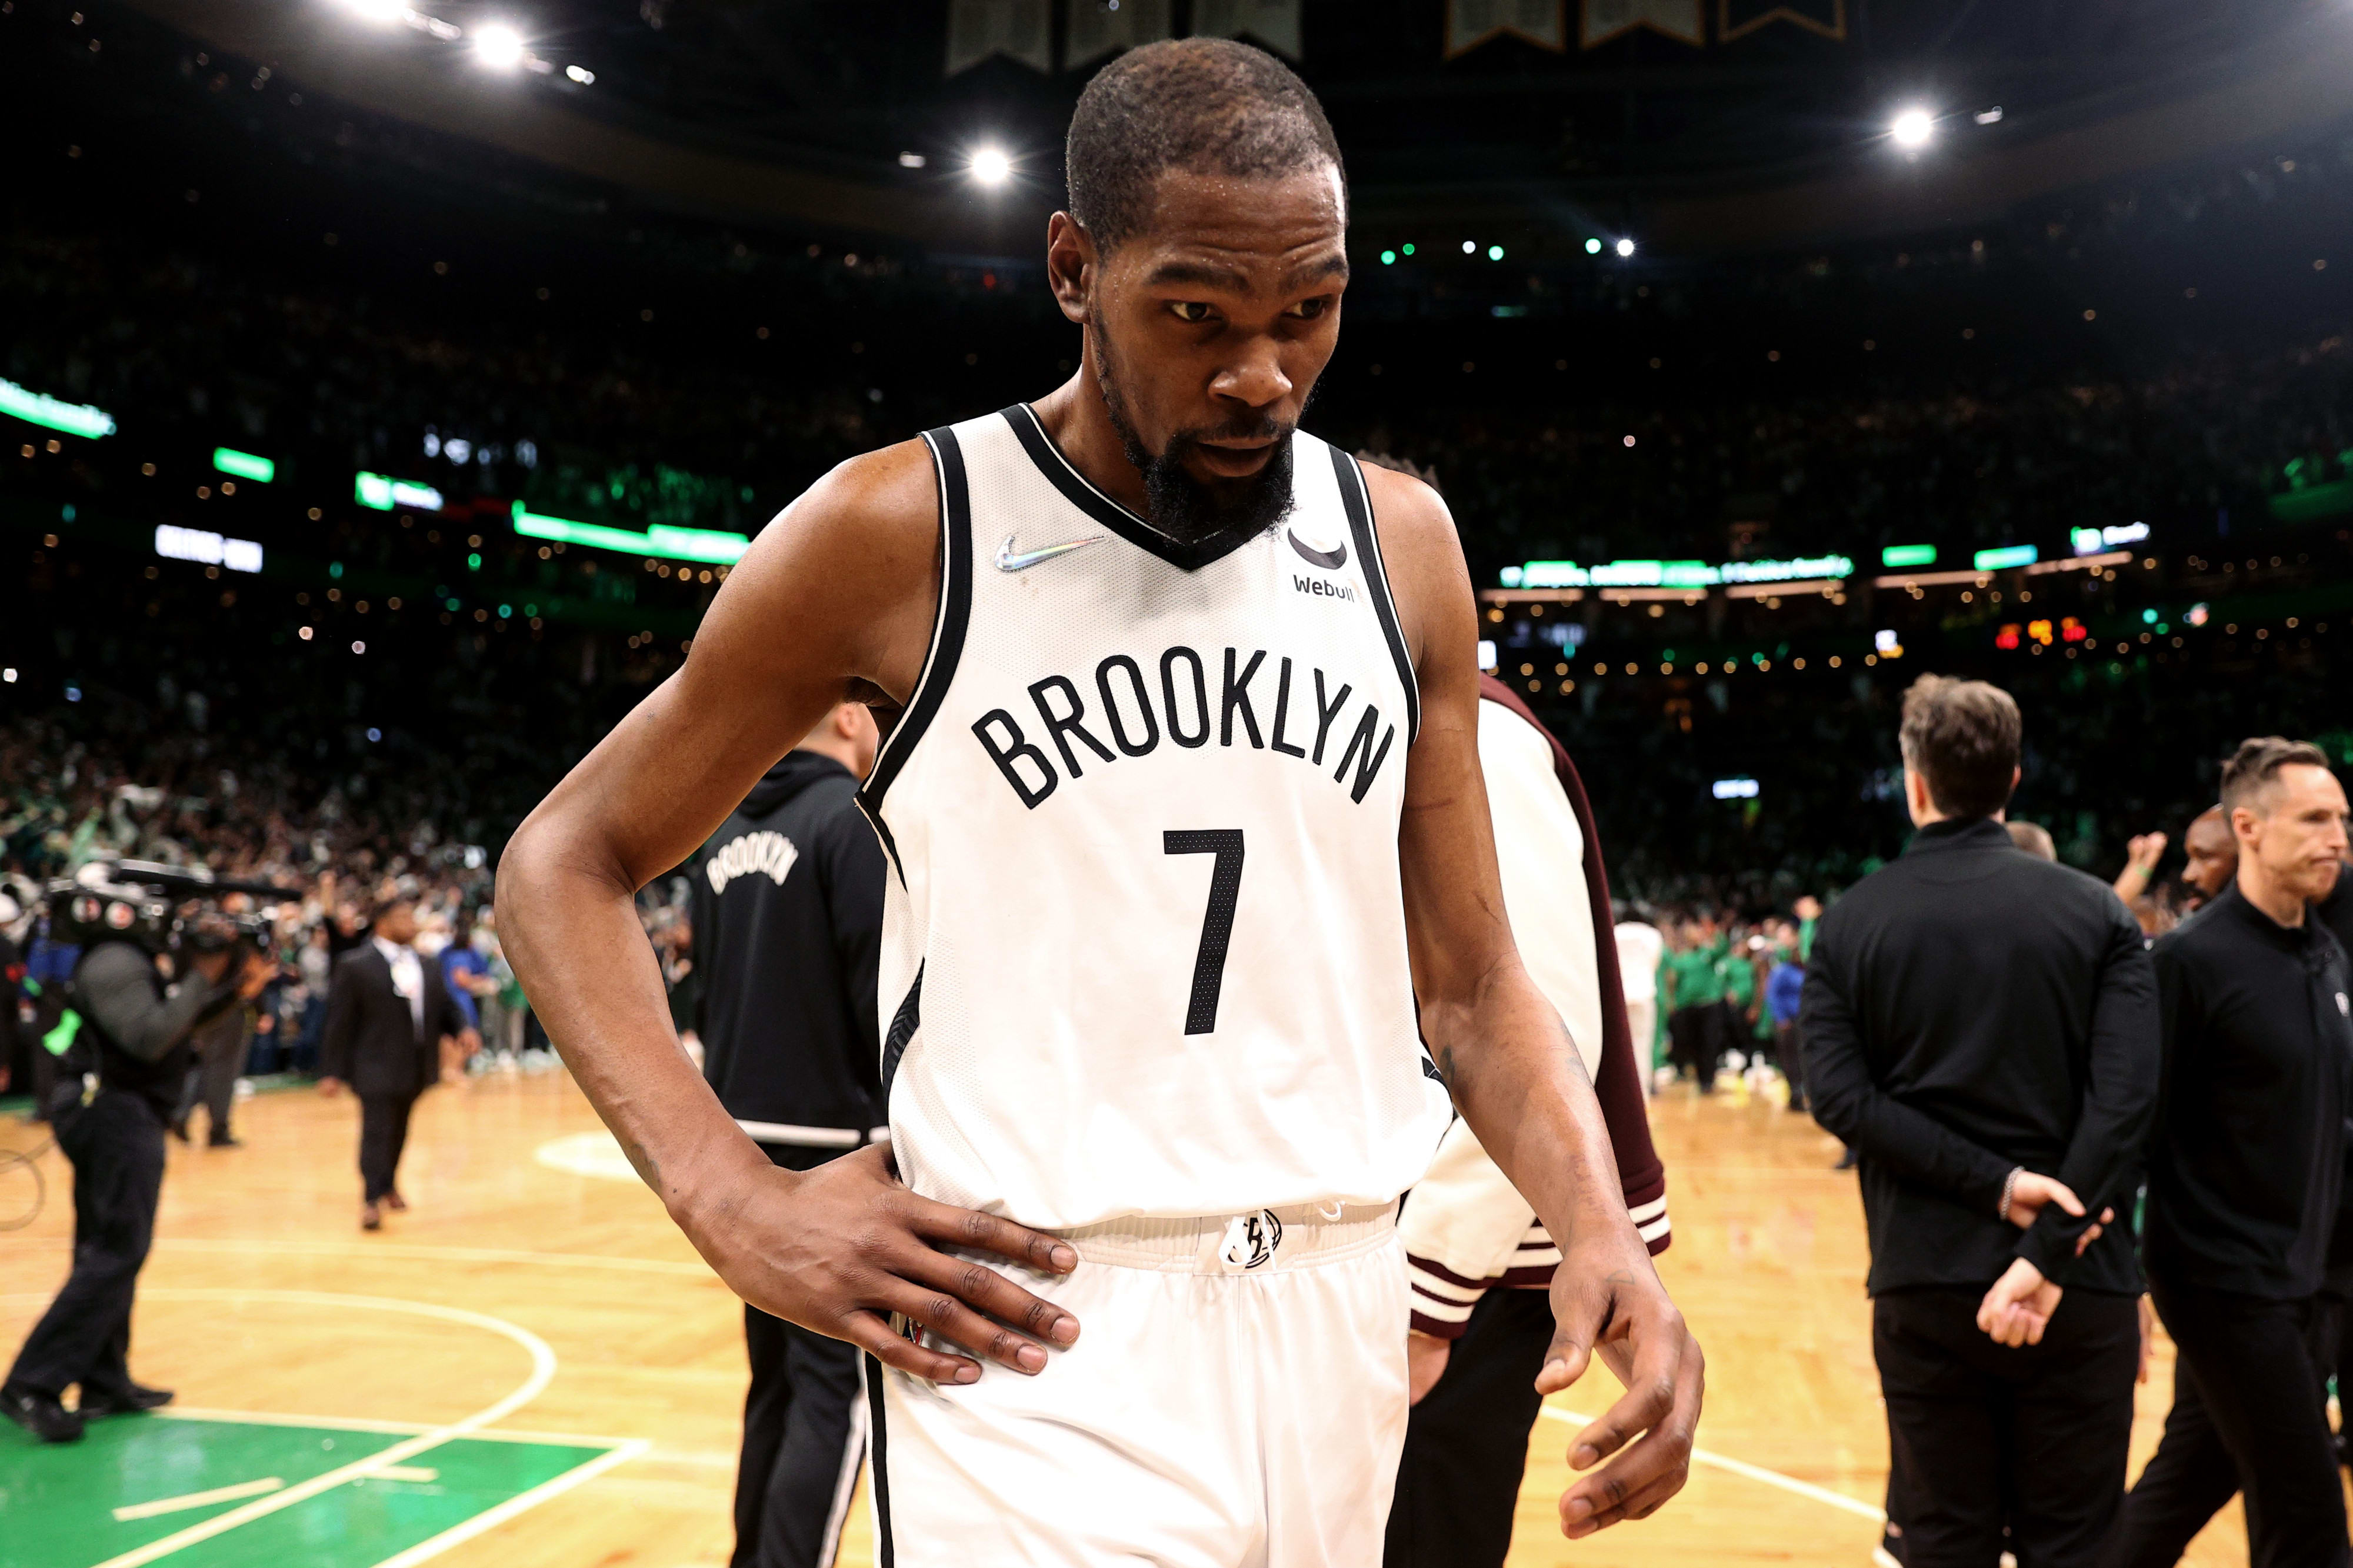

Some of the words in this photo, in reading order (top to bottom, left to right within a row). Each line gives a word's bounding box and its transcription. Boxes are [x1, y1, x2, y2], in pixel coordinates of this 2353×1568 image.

[1294, 574, 1354, 603] Webull
[972, 646, 1394, 810] BROOKLYN
[1163, 829, 1245, 1035] 7
